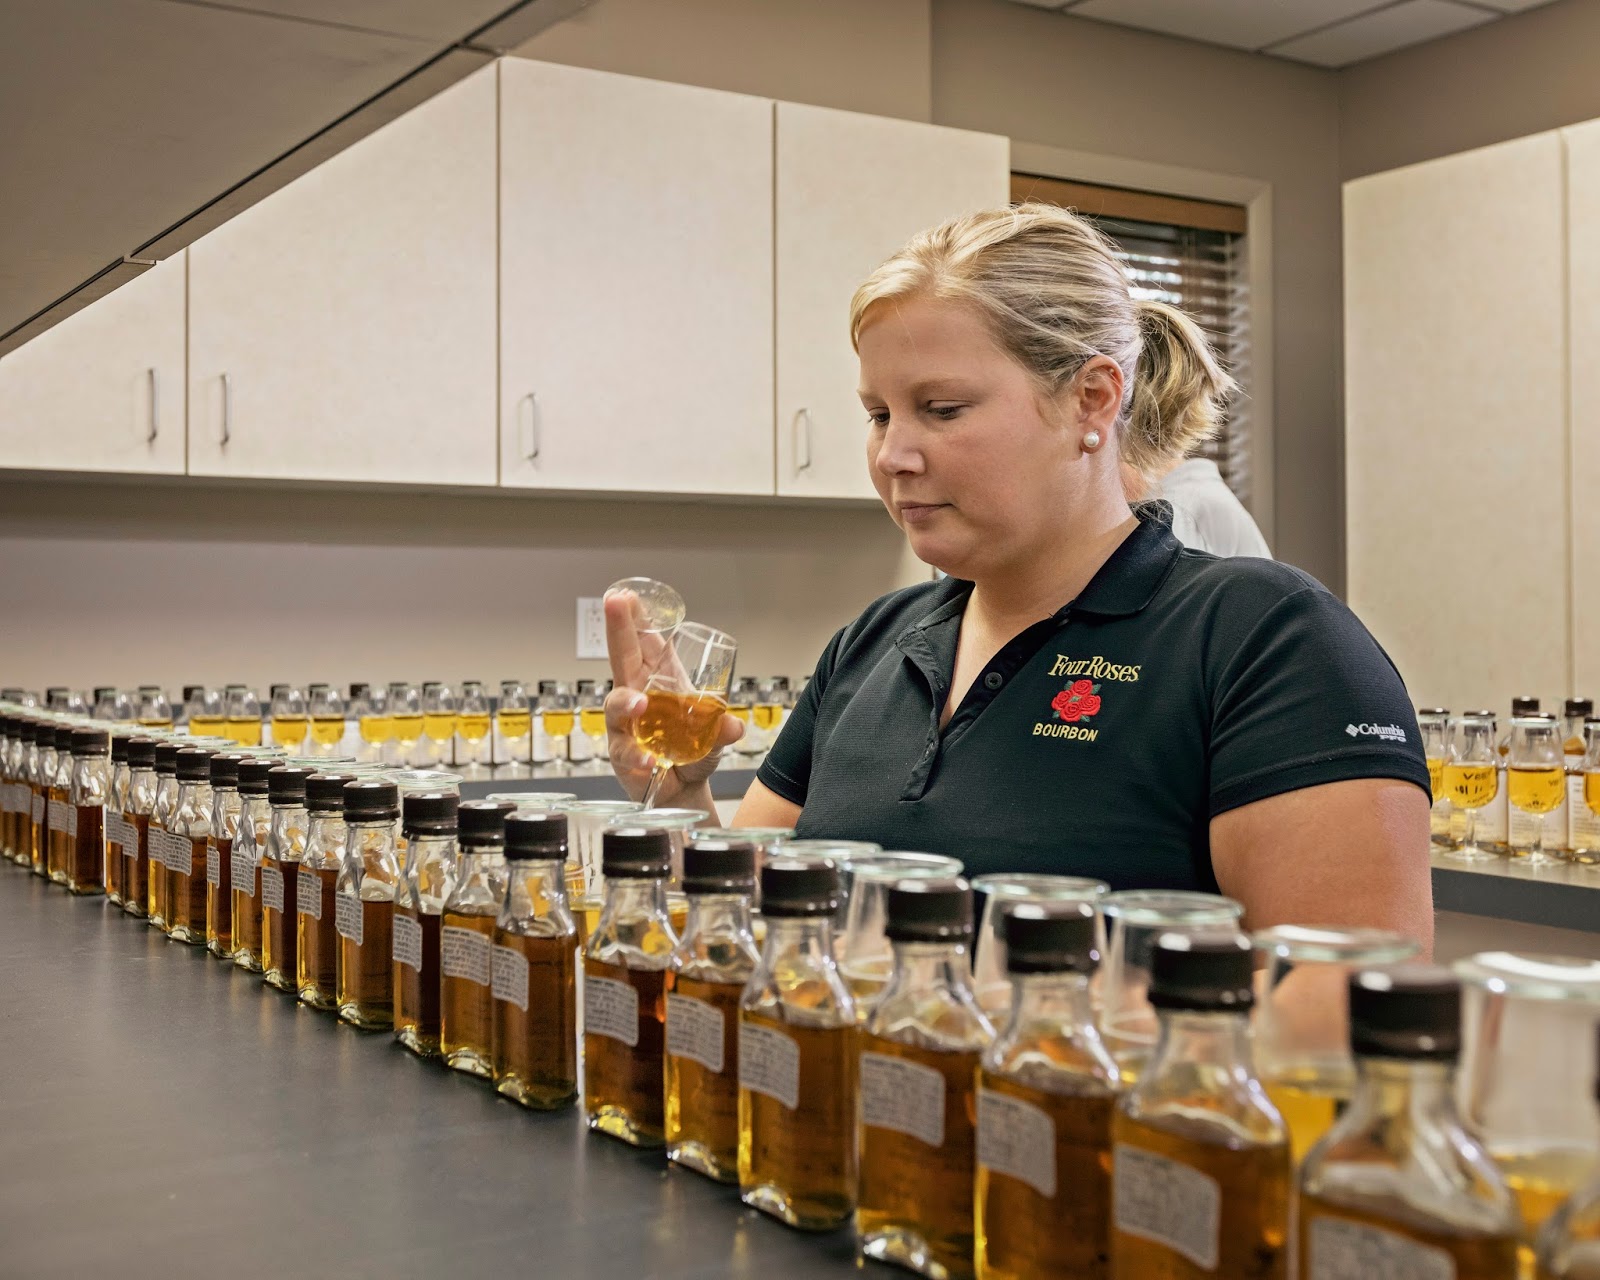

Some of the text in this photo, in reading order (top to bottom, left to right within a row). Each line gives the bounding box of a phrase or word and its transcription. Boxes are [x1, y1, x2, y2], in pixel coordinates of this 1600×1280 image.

[1048, 654, 1142, 682] Four Roses
[1032, 722, 1099, 742] BOURBON
[1358, 723, 1406, 738] Columbia
